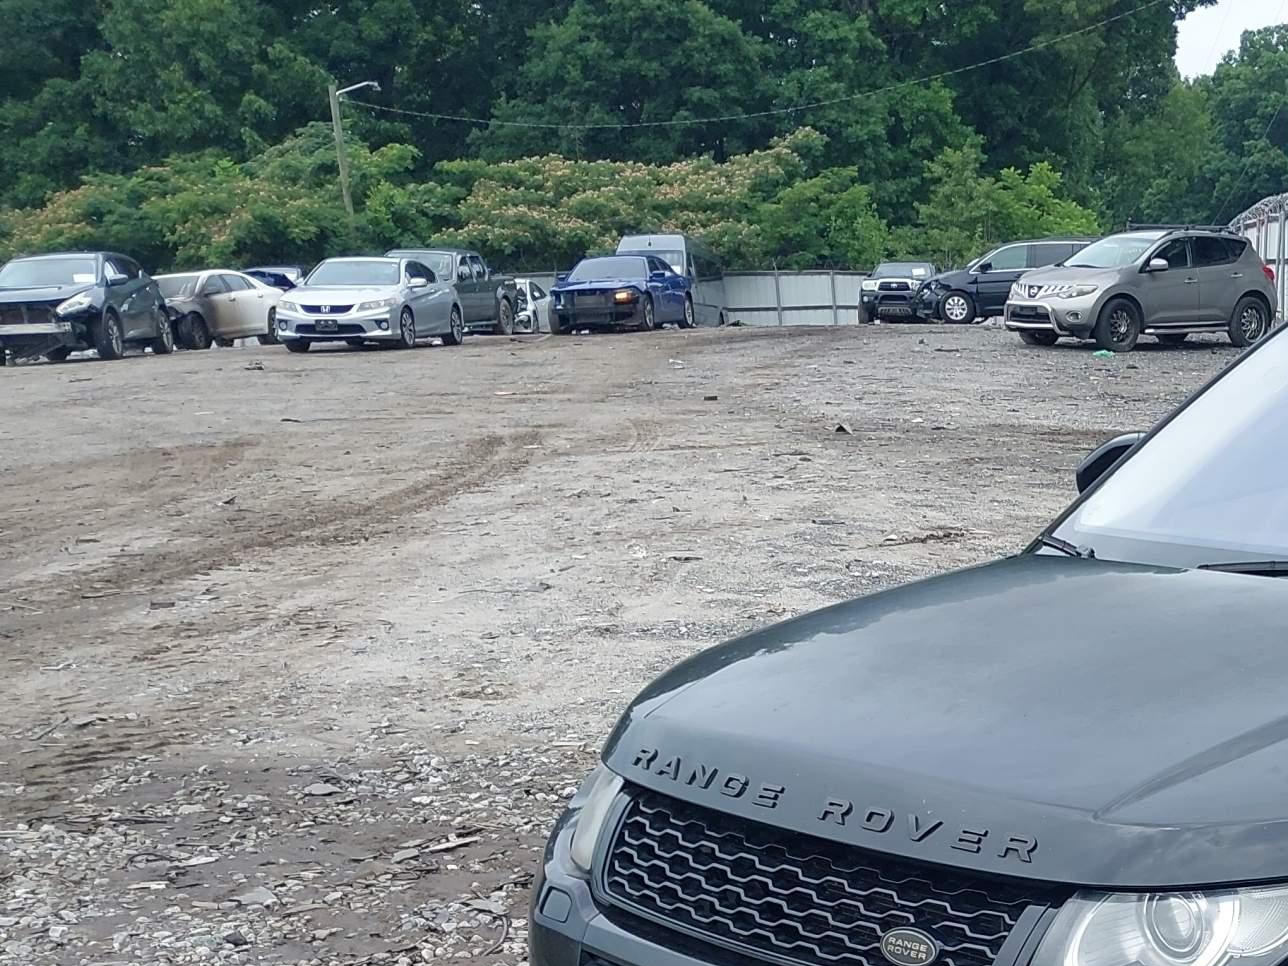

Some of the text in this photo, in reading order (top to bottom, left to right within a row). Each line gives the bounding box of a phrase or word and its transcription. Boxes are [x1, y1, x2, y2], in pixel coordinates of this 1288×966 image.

[631, 747, 1039, 864] RANGE ROVER
[886, 944, 927, 960] ROVER
[887, 936, 928, 952] RANGE
